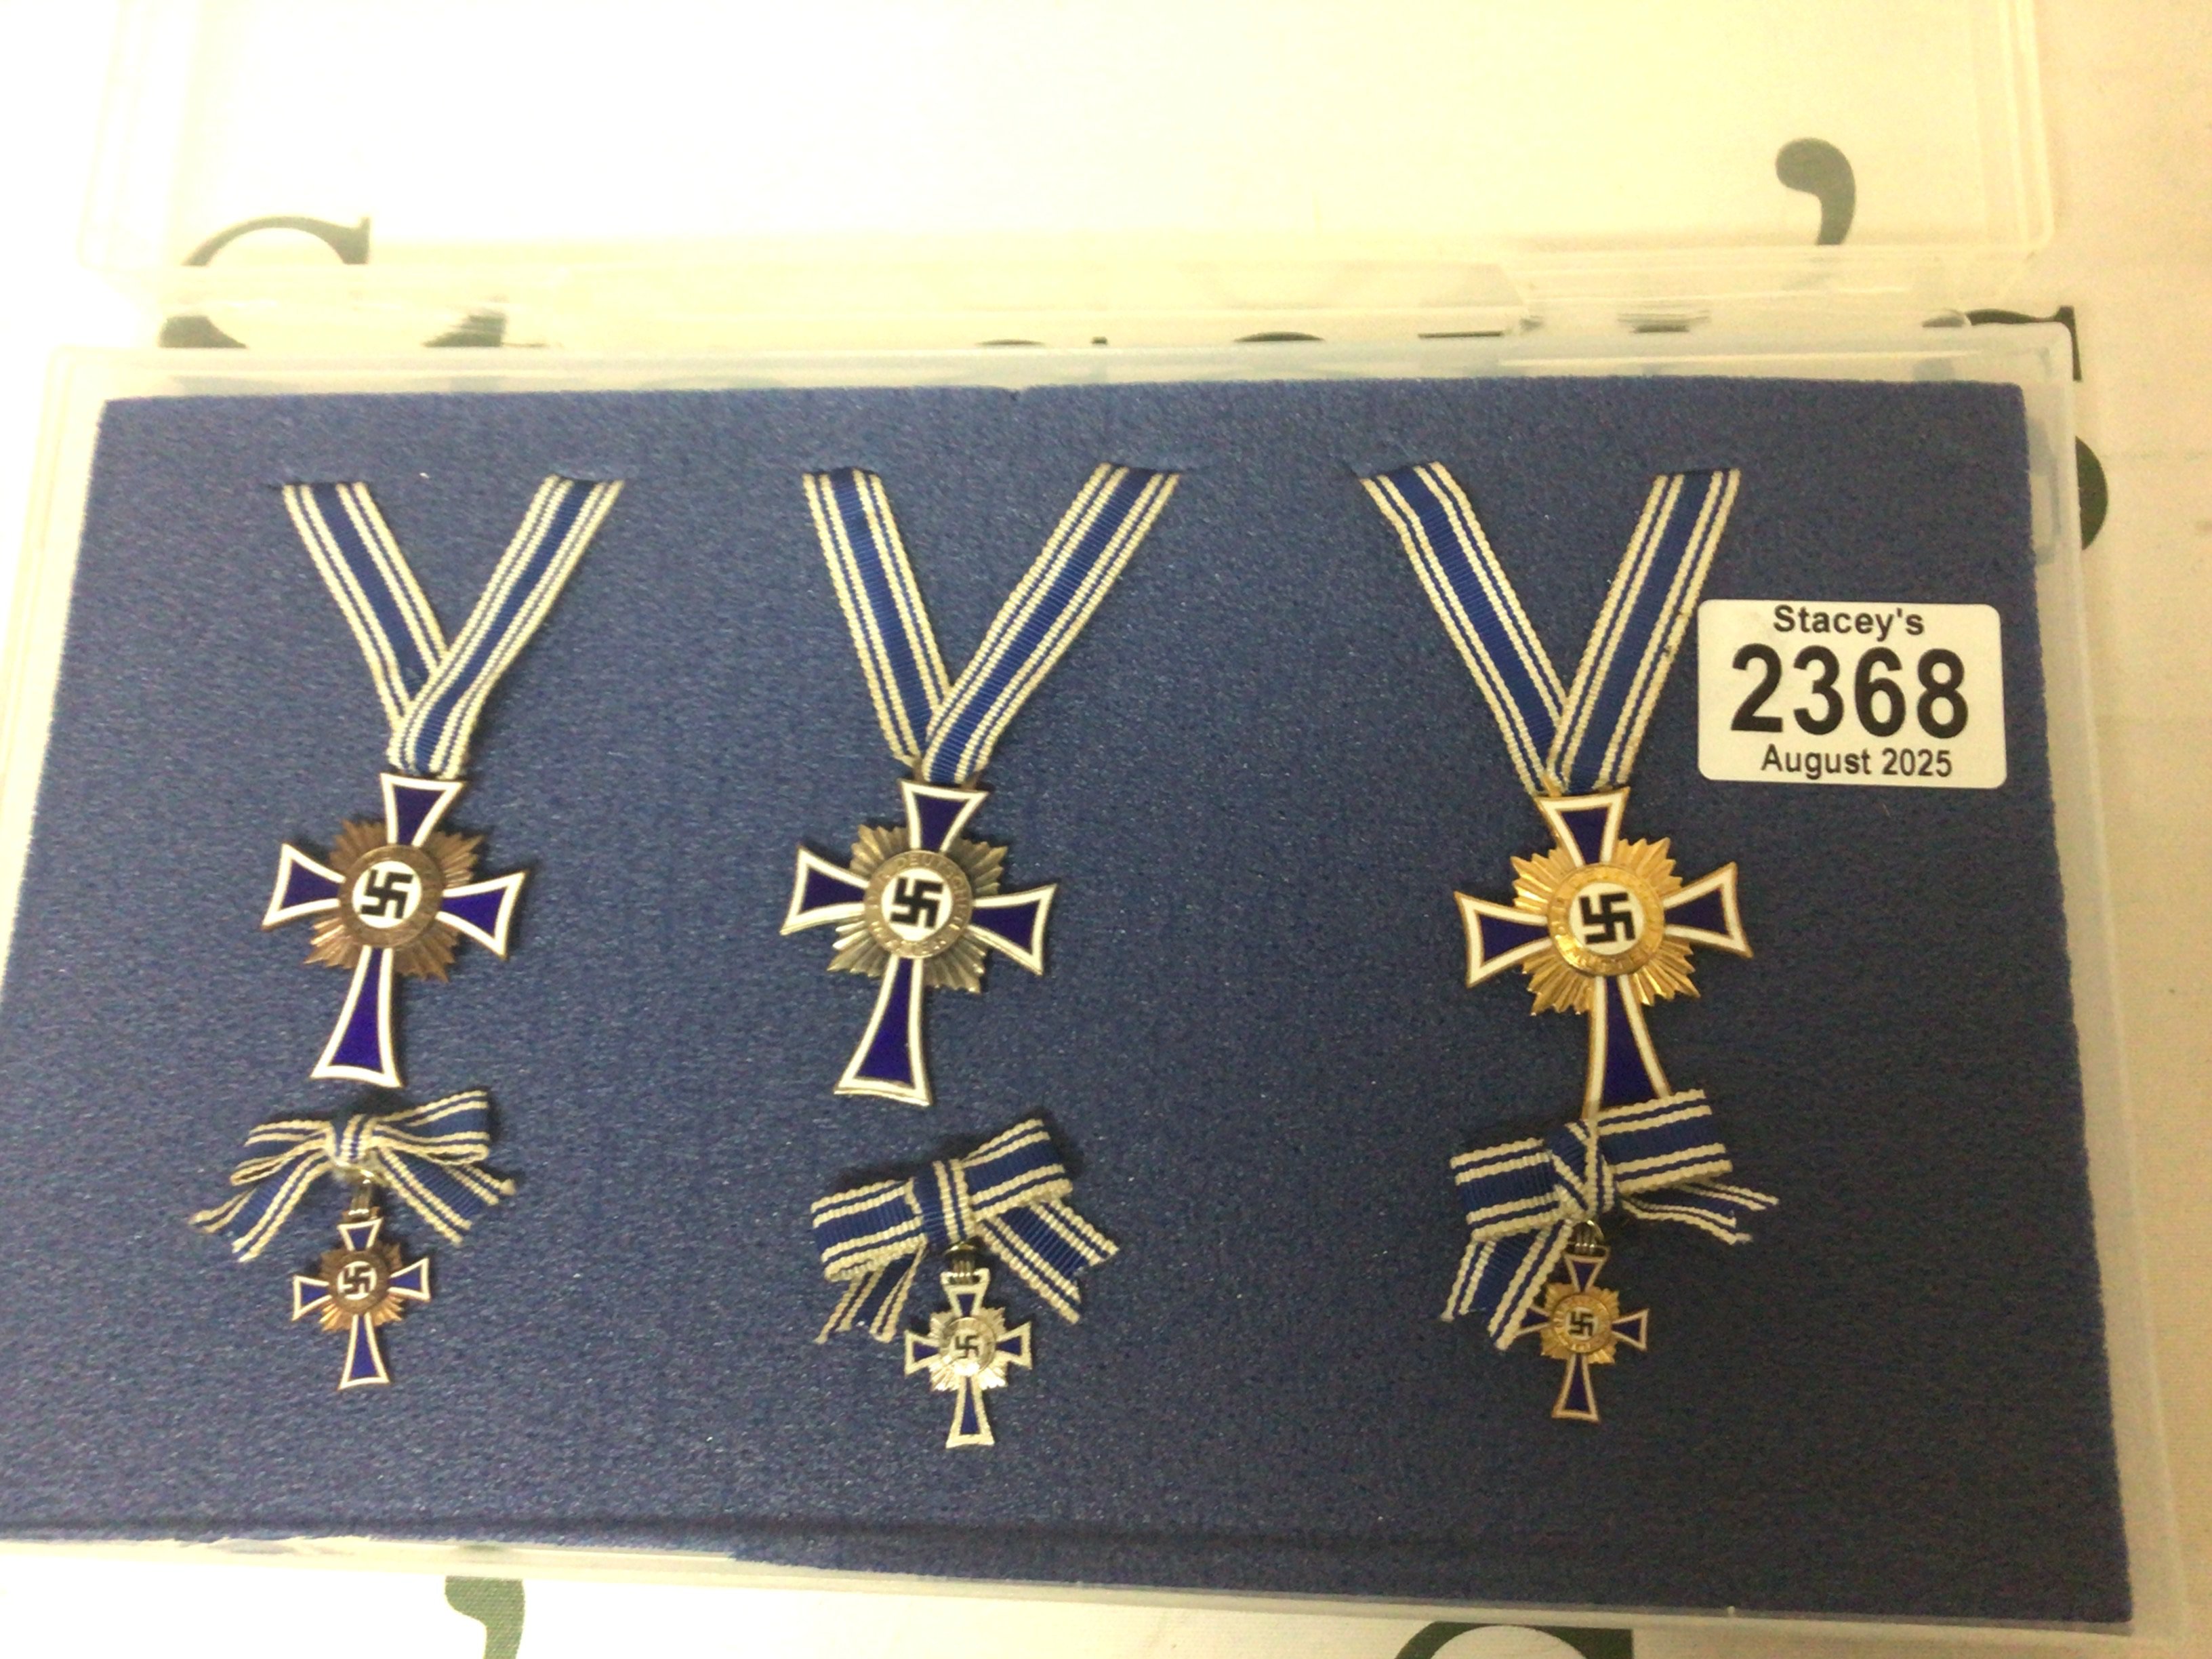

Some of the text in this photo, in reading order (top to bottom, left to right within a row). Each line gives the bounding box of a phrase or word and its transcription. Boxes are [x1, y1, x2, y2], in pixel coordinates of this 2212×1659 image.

[1774, 605, 1925, 641] Stacey's
[1731, 643, 1968, 739] 2368
[1761, 744, 1952, 779] August 2025
